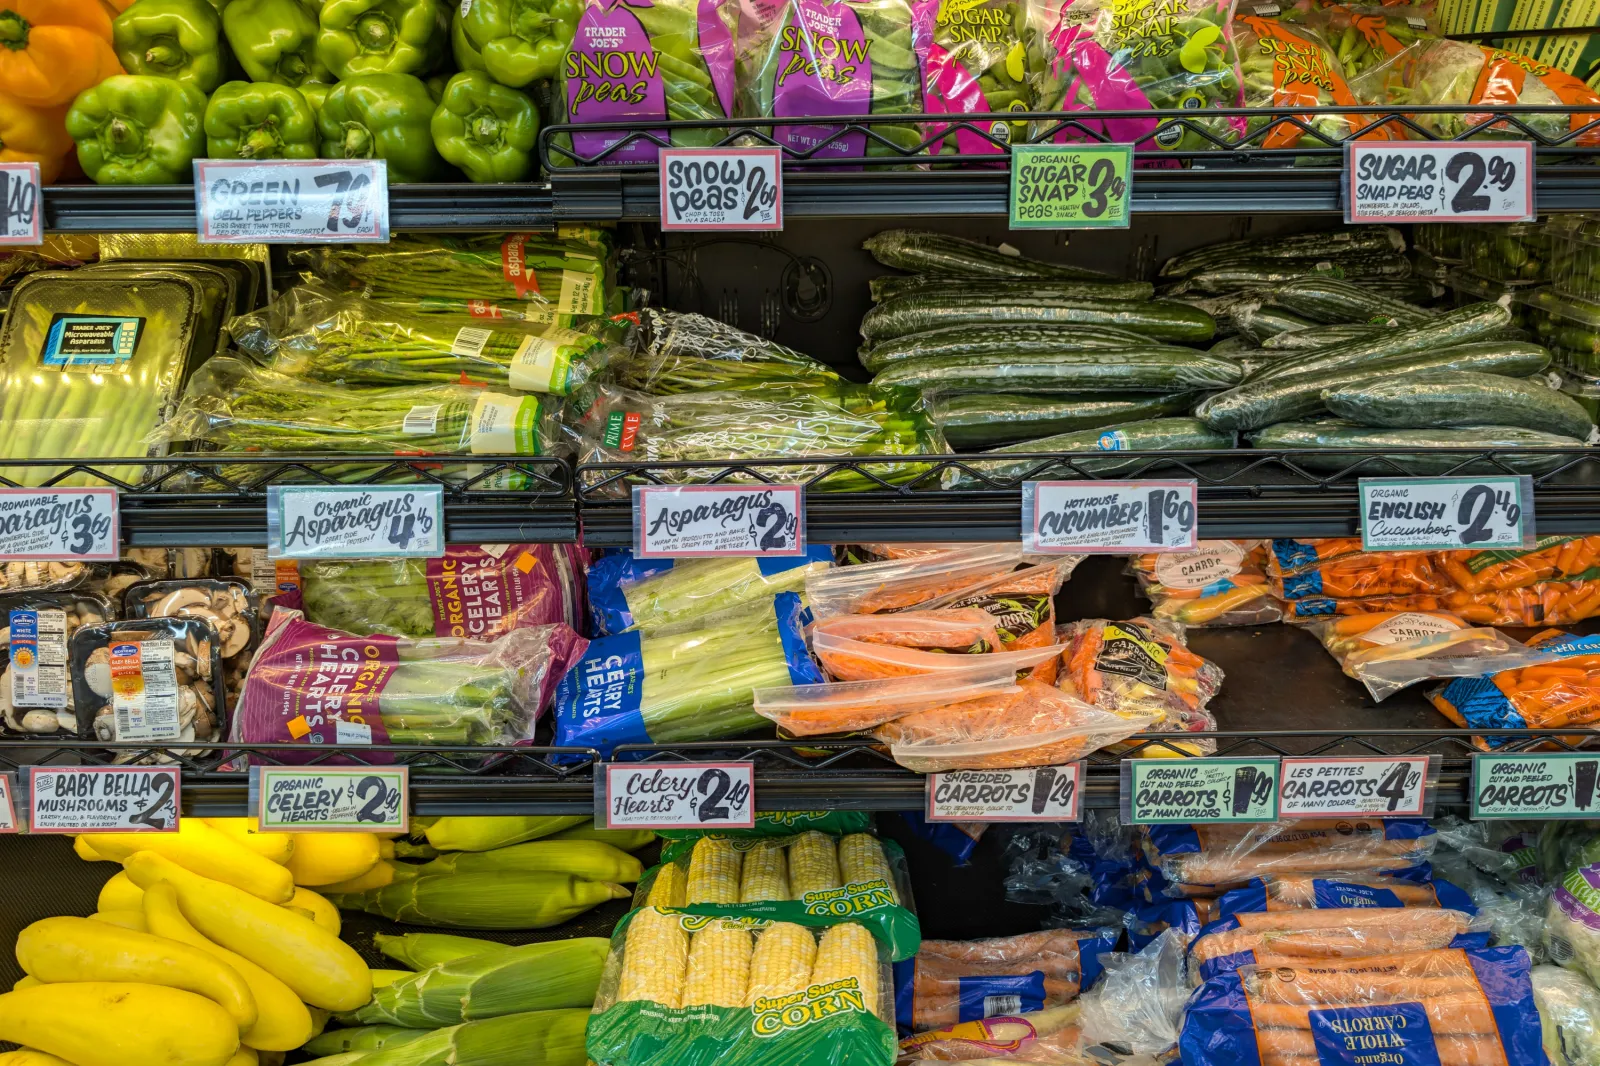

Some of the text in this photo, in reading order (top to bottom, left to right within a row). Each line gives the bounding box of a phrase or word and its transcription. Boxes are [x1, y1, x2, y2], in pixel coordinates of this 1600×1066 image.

[805, 9, 842, 26] TRADER
[1110, 0, 1189, 30] SUGAR
[584, 27, 626, 37] TRADER
[950, 25, 1002, 43] SNAP
[1115, 15, 1180, 43] SNAP
[780, 26, 873, 64] SNOW
[566, 51, 662, 78] SNOW
[778, 53, 856, 87] peas
[1280, 70, 1335, 94] peas
[571, 80, 648, 115] peas
[787, 134, 799, 143] NET
[1031, 155, 1080, 164] ORGANIC
[1357, 153, 1437, 181] SUGAR
[1019, 164, 1087, 185] SUGAR
[210, 178, 301, 206] GREEN
[670, 185, 739, 220] peas
[1018, 184, 1078, 203] SNAP
[1356, 184, 1434, 201] SNAP PEAS
[213, 208, 301, 221] BELL PEPPERS
[606, 414, 623, 446] PRIME
[1371, 489, 1409, 498] ORGANIC
[314, 492, 372, 517] Organic
[647, 490, 772, 537] Asparagus
[1368, 501, 1446, 521] ENGLISH
[285, 493, 415, 547] Asparagus
[1039, 501, 1143, 537] CUCUMBER
[1370, 519, 1456, 537] Cucumbers
[32, 529, 45, 537] SIDE
[662, 543, 679, 551] UNTIL
[681, 541, 700, 549] CRISPY
[720, 534, 748, 544] DELICIOUS
[12, 541, 29, 549] QUICK
[13, 545, 26, 553] EASY
[442, 559, 465, 638] ORGANIC
[461, 561, 485, 634] CELERY
[479, 557, 503, 634] HEARTS
[1112, 640, 1157, 669] CARROTS
[305, 644, 338, 727] HEARTS
[325, 647, 360, 723] CELERY
[347, 645, 380, 725] ORGANIC
[603, 655, 625, 710] CELERY
[942, 773, 1012, 784] SHREDDED
[1147, 768, 1198, 780] ORGANIC
[1290, 766, 1365, 778] LES PETITES
[1491, 762, 1546, 775] ORGANIC
[36, 777, 54, 788] SLICED
[55, 773, 150, 797] BABY BELLA
[273, 777, 323, 792] ORGANIC
[626, 769, 697, 800] Celery
[1175, 780, 1205, 788] PEELED
[1281, 779, 1378, 800] CARROTS
[267, 787, 343, 813] CELERY
[935, 783, 1031, 804] CARROTS
[1136, 789, 1218, 808] CARROTS
[1479, 784, 1568, 807] CARROTS
[37, 799, 128, 812] MUSHROOMS
[281, 808, 329, 822] HEARTS
[613, 794, 675, 816] Hearts
[1138, 808, 1220, 818] OF MANY COLORS
[802, 878, 889, 903] Super Sweet
[805, 889, 898, 916] CORN
[753, 977, 860, 1014] Super Sweet
[752, 989, 866, 1037] CORN
[1331, 1014, 1407, 1033] CARROTS
[1344, 1033, 1405, 1050] WHOLE
[1354, 1052, 1404, 1066] Organic
